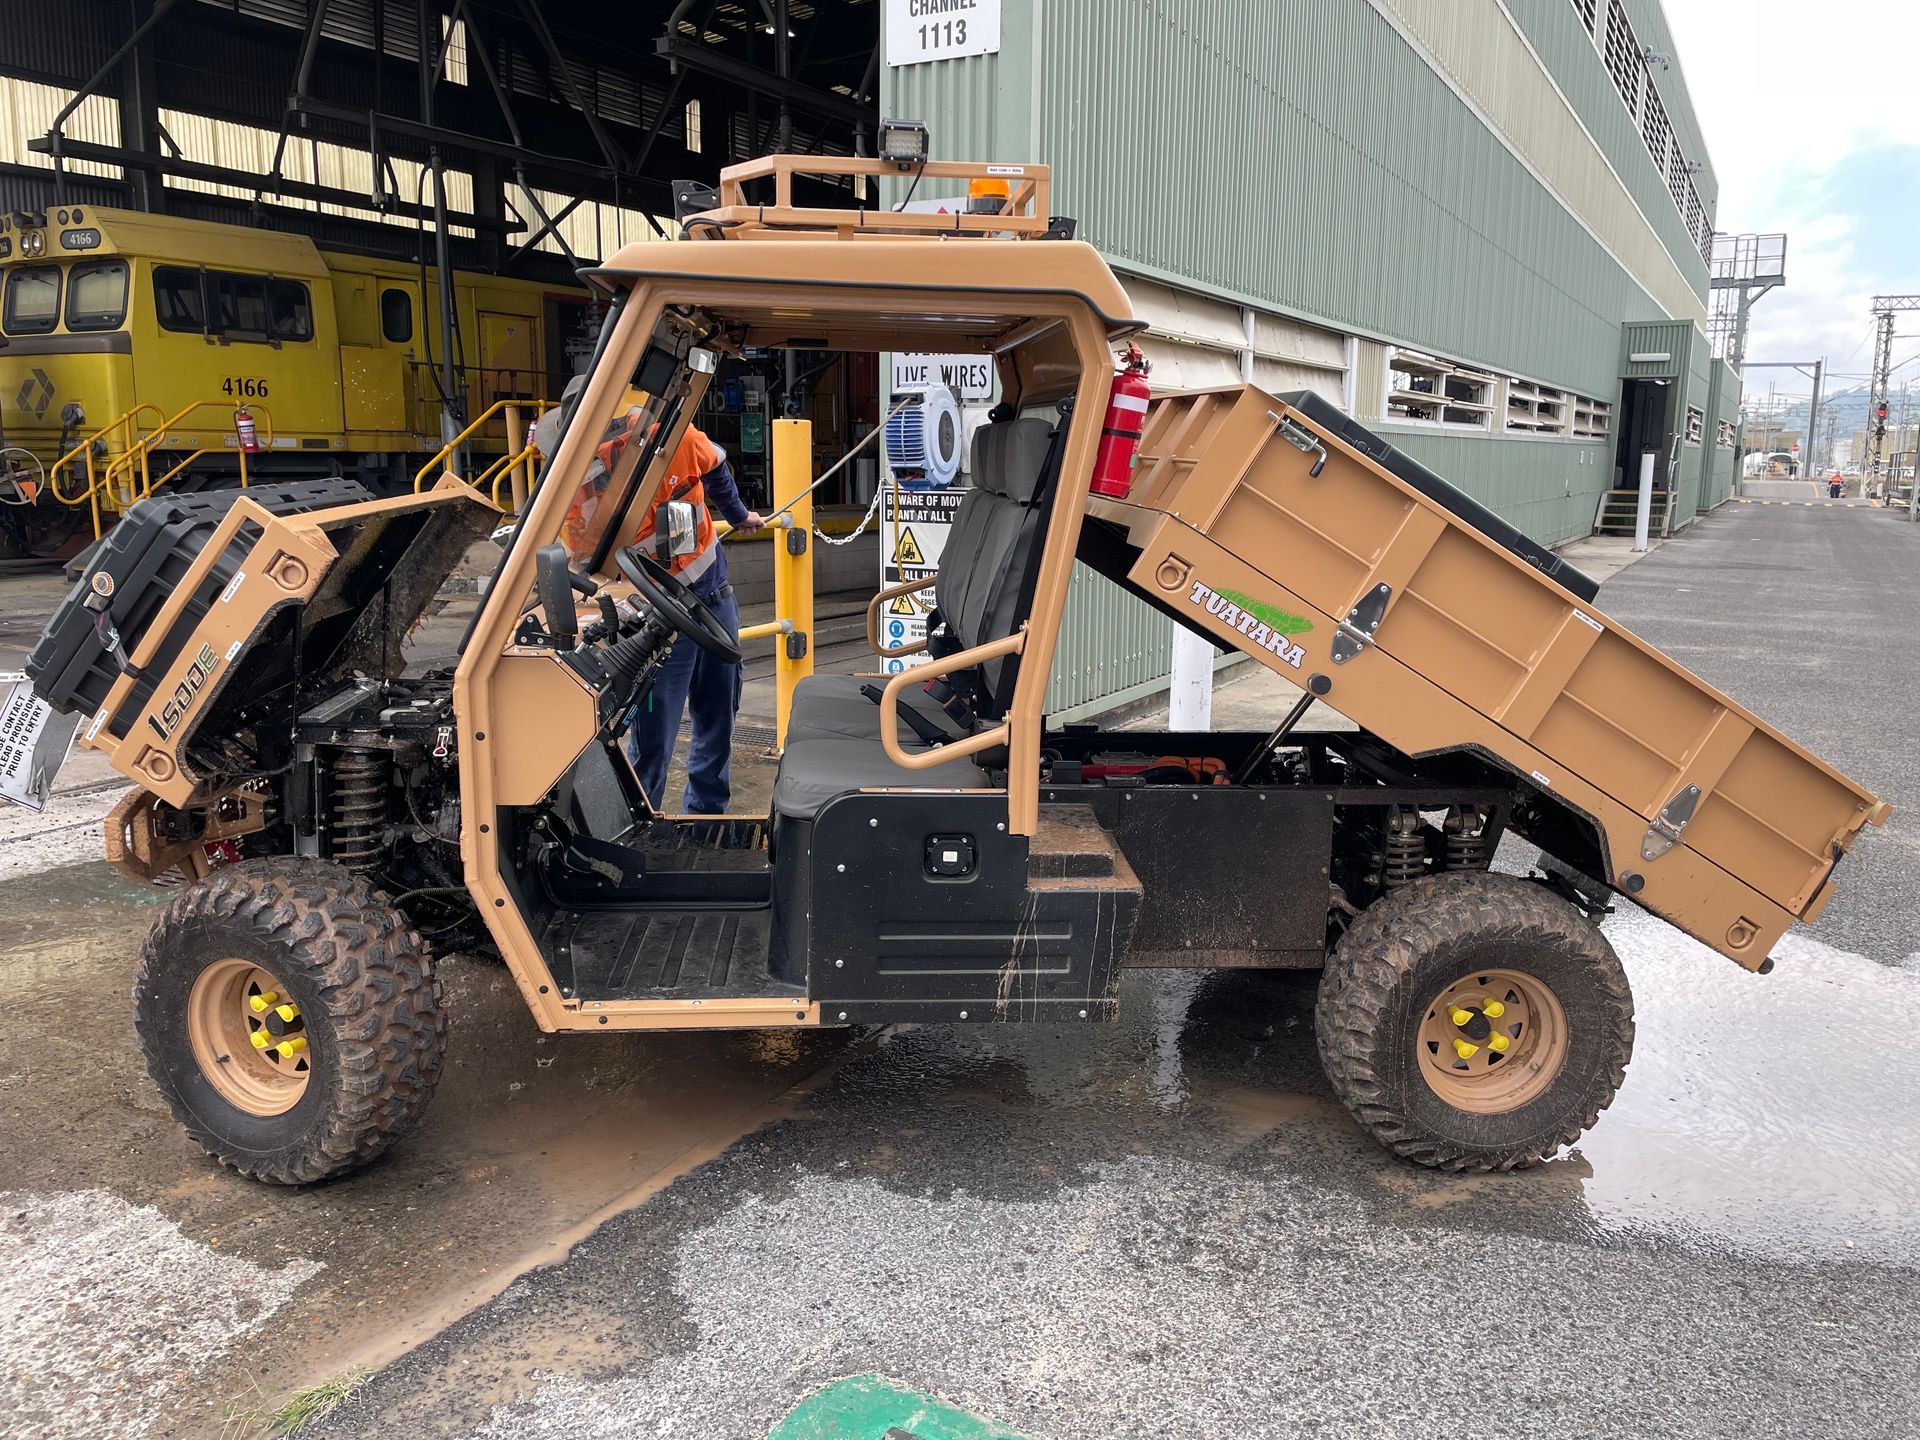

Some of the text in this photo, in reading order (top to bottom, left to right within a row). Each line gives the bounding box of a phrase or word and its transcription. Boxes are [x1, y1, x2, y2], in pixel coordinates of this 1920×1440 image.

[918, 19, 967, 50] 1113
[70, 233, 92, 245] 4166
[222, 377, 269, 398] 4166
[896, 364, 987, 388] LIVE WIRES
[887, 494, 963, 507] BWARE OF MOV
[887, 509, 915, 521] PANT
[917, 510, 928, 521] AT
[930, 510, 947, 522] ALL
[1189, 580, 1308, 670] TUATARA
[148, 642, 220, 744] 1500E
[2, 694, 26, 735] CONTACT
[9, 691, 38, 744] PROVISIONE
[5, 704, 44, 777] PRIOR TO ENTRY
